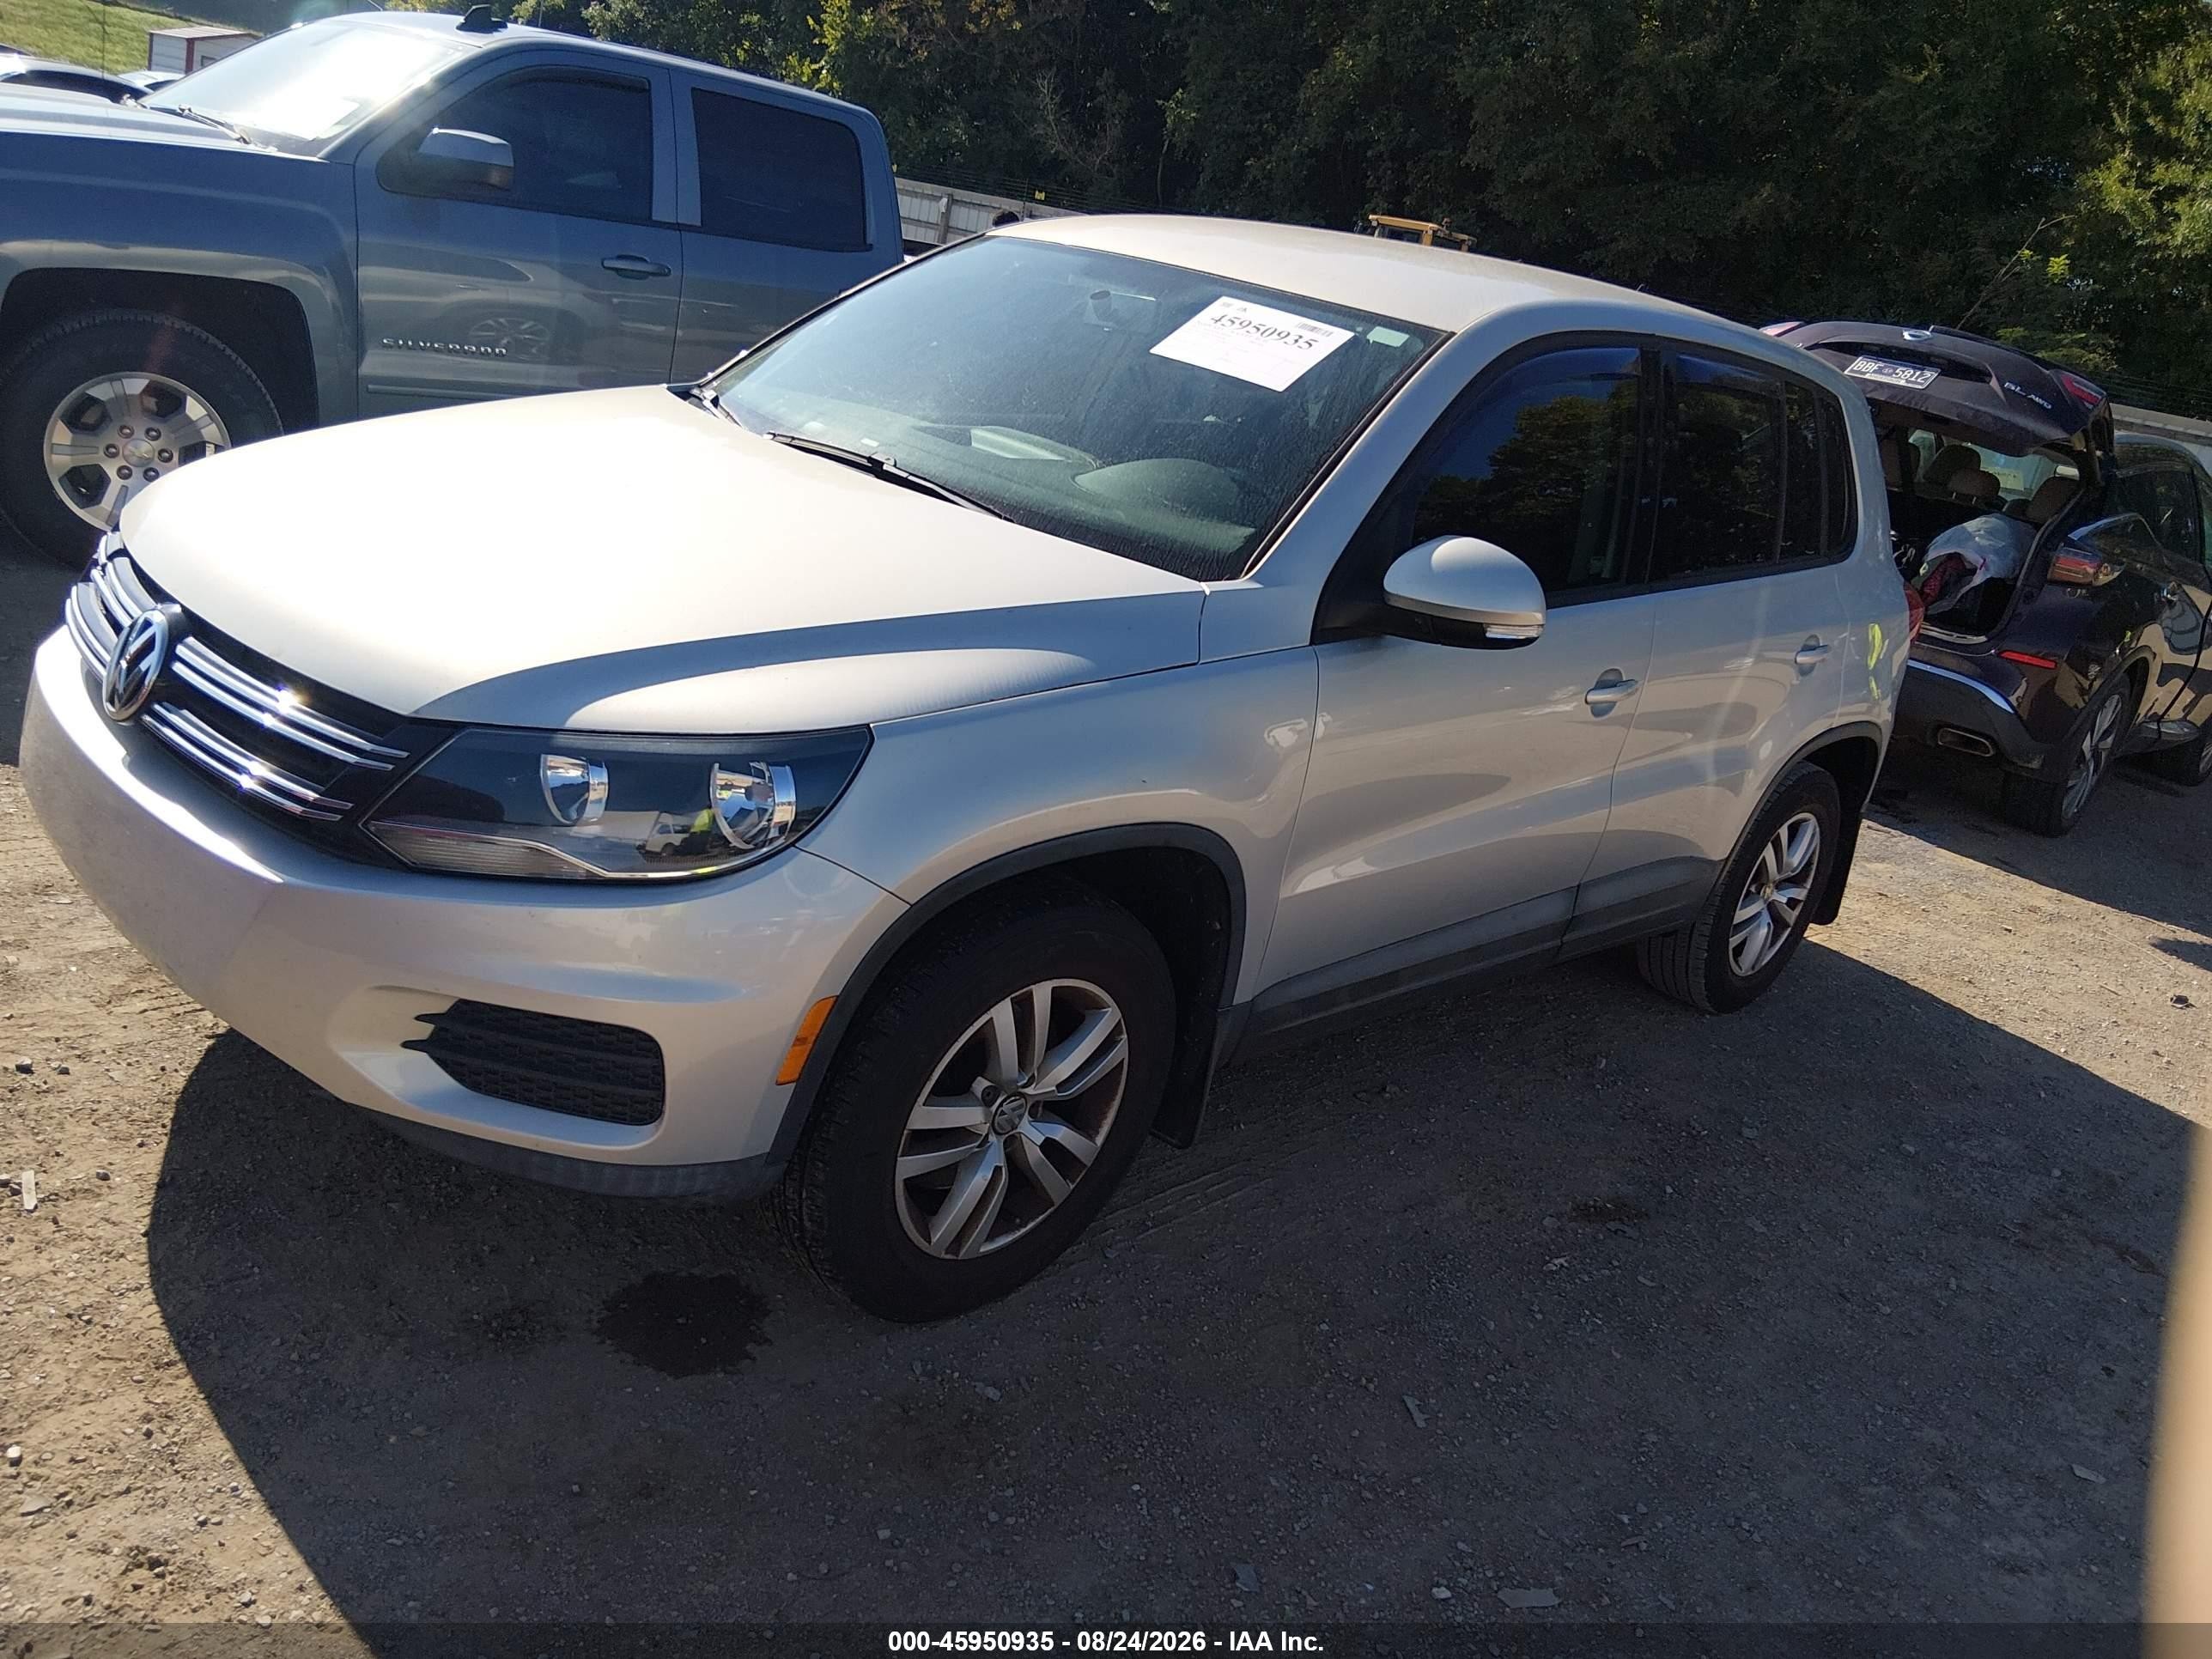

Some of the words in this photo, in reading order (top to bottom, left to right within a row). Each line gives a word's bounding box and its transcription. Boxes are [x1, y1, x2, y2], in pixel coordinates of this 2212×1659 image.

[1210, 313, 1320, 351] 45950935
[1852, 361, 1884, 374] BBF
[1892, 368, 1936, 383] 5812
[2027, 394, 2052, 410] AWD
